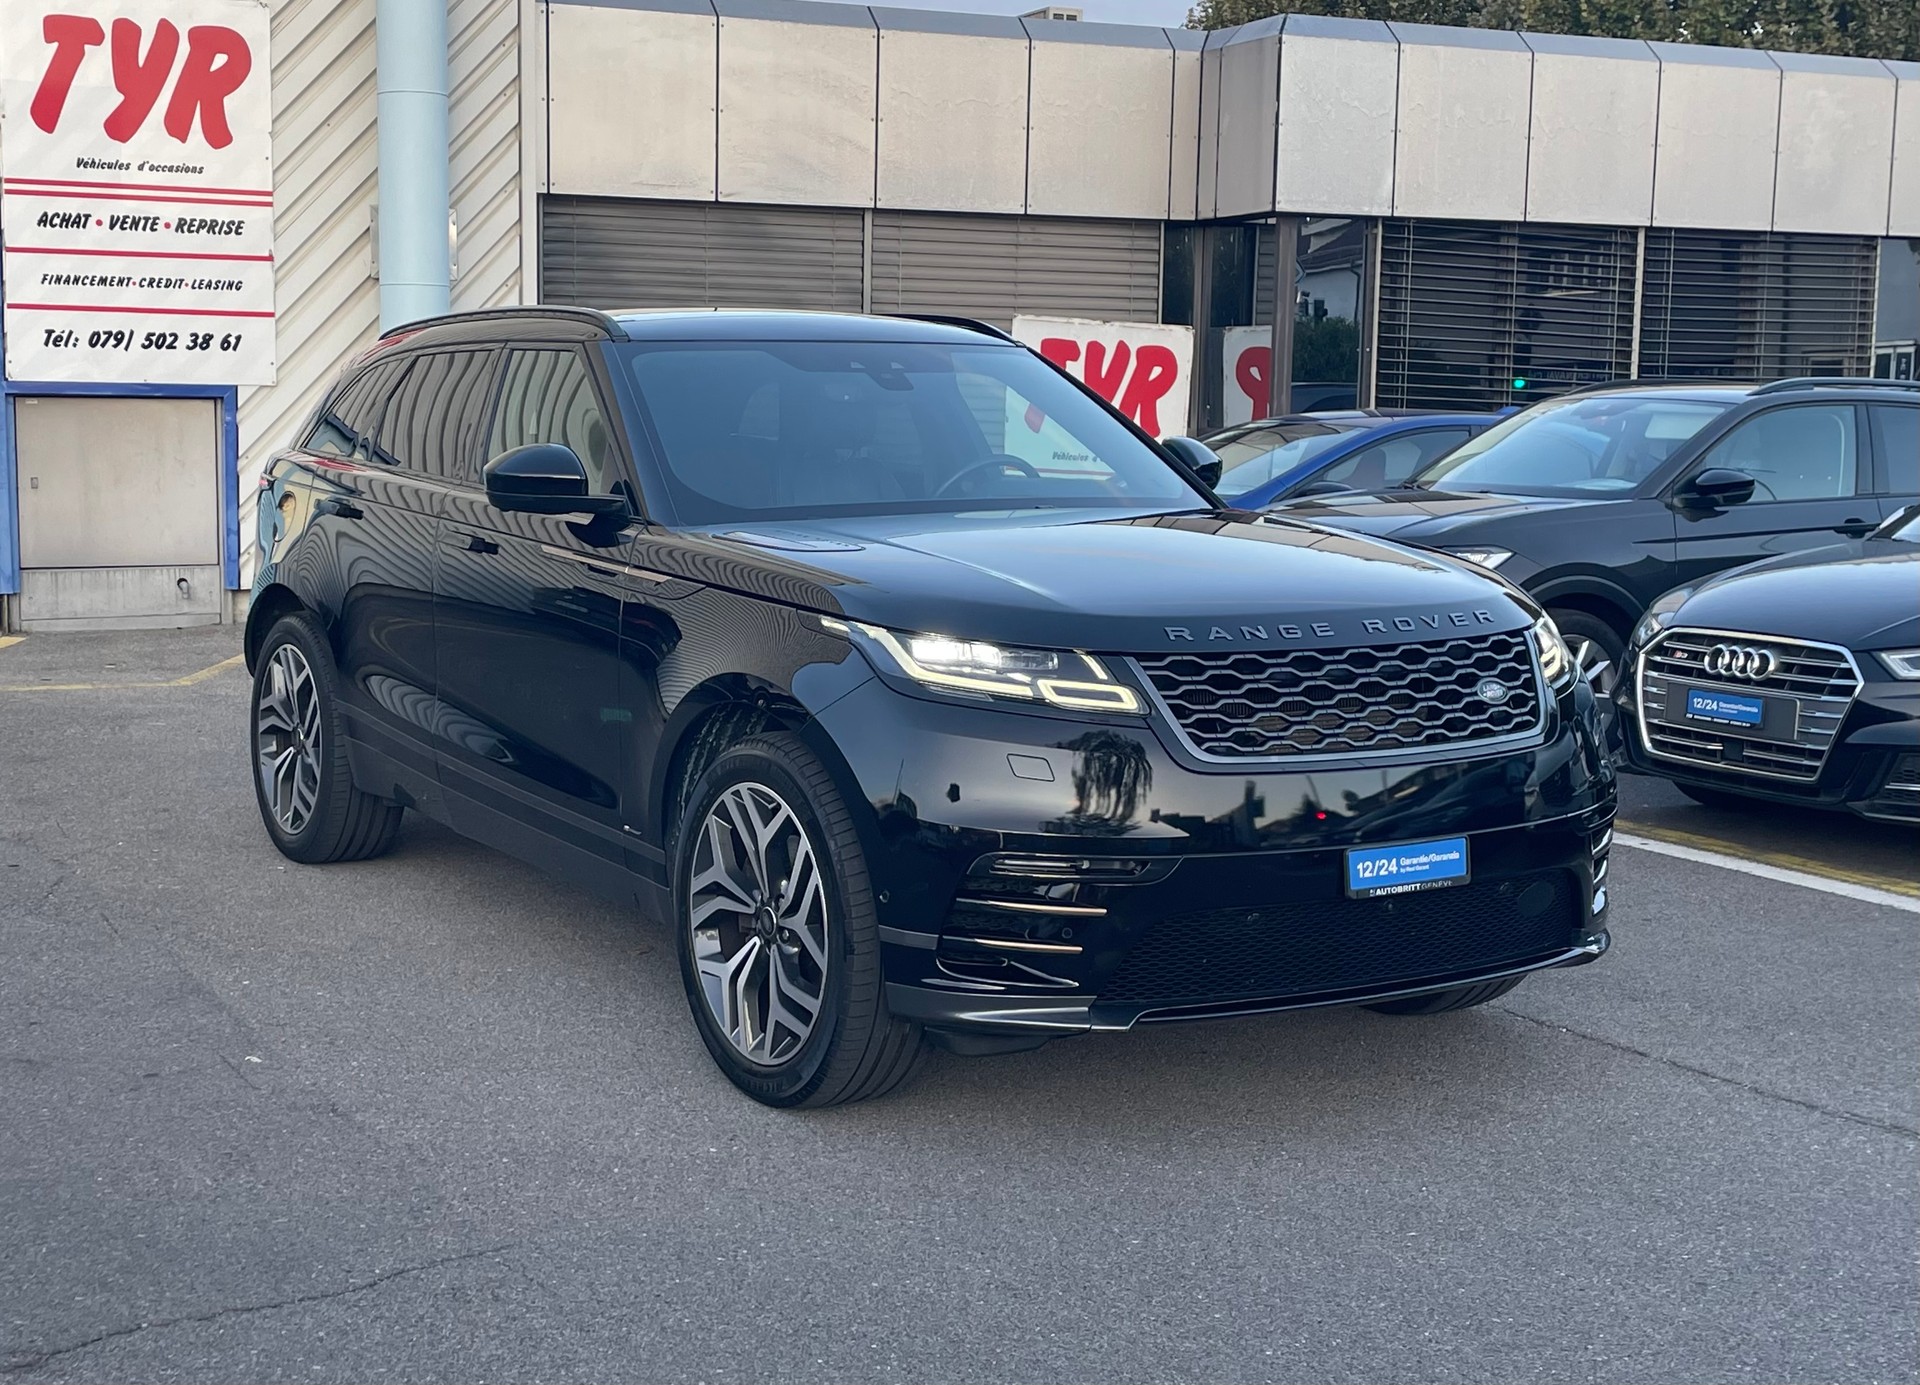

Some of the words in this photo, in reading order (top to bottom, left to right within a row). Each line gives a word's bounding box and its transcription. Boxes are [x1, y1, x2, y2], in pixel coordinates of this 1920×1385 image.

[30, 14, 252, 149] TYR
[76, 157, 131, 171] Véhicules
[137, 160, 204, 175] d'occasions
[37, 211, 92, 230] ACHAT
[108, 214, 160, 232] VENTE
[174, 217, 245, 236] REPRISE
[41, 273, 133, 288] FINANCEMENT
[138, 277, 185, 290] CREDIT
[190, 278, 243, 291] LEASING
[43, 329, 80, 349] Tél:
[140, 332, 179, 350] 502
[186, 332, 214, 351] 38
[219, 334, 242, 352] 61
[1163, 622, 1335, 642] RANGE
[1361, 609, 1496, 634] ROVER
[1693, 698, 1718, 711] 12/24
[1357, 858, 1398, 878] 12/24
